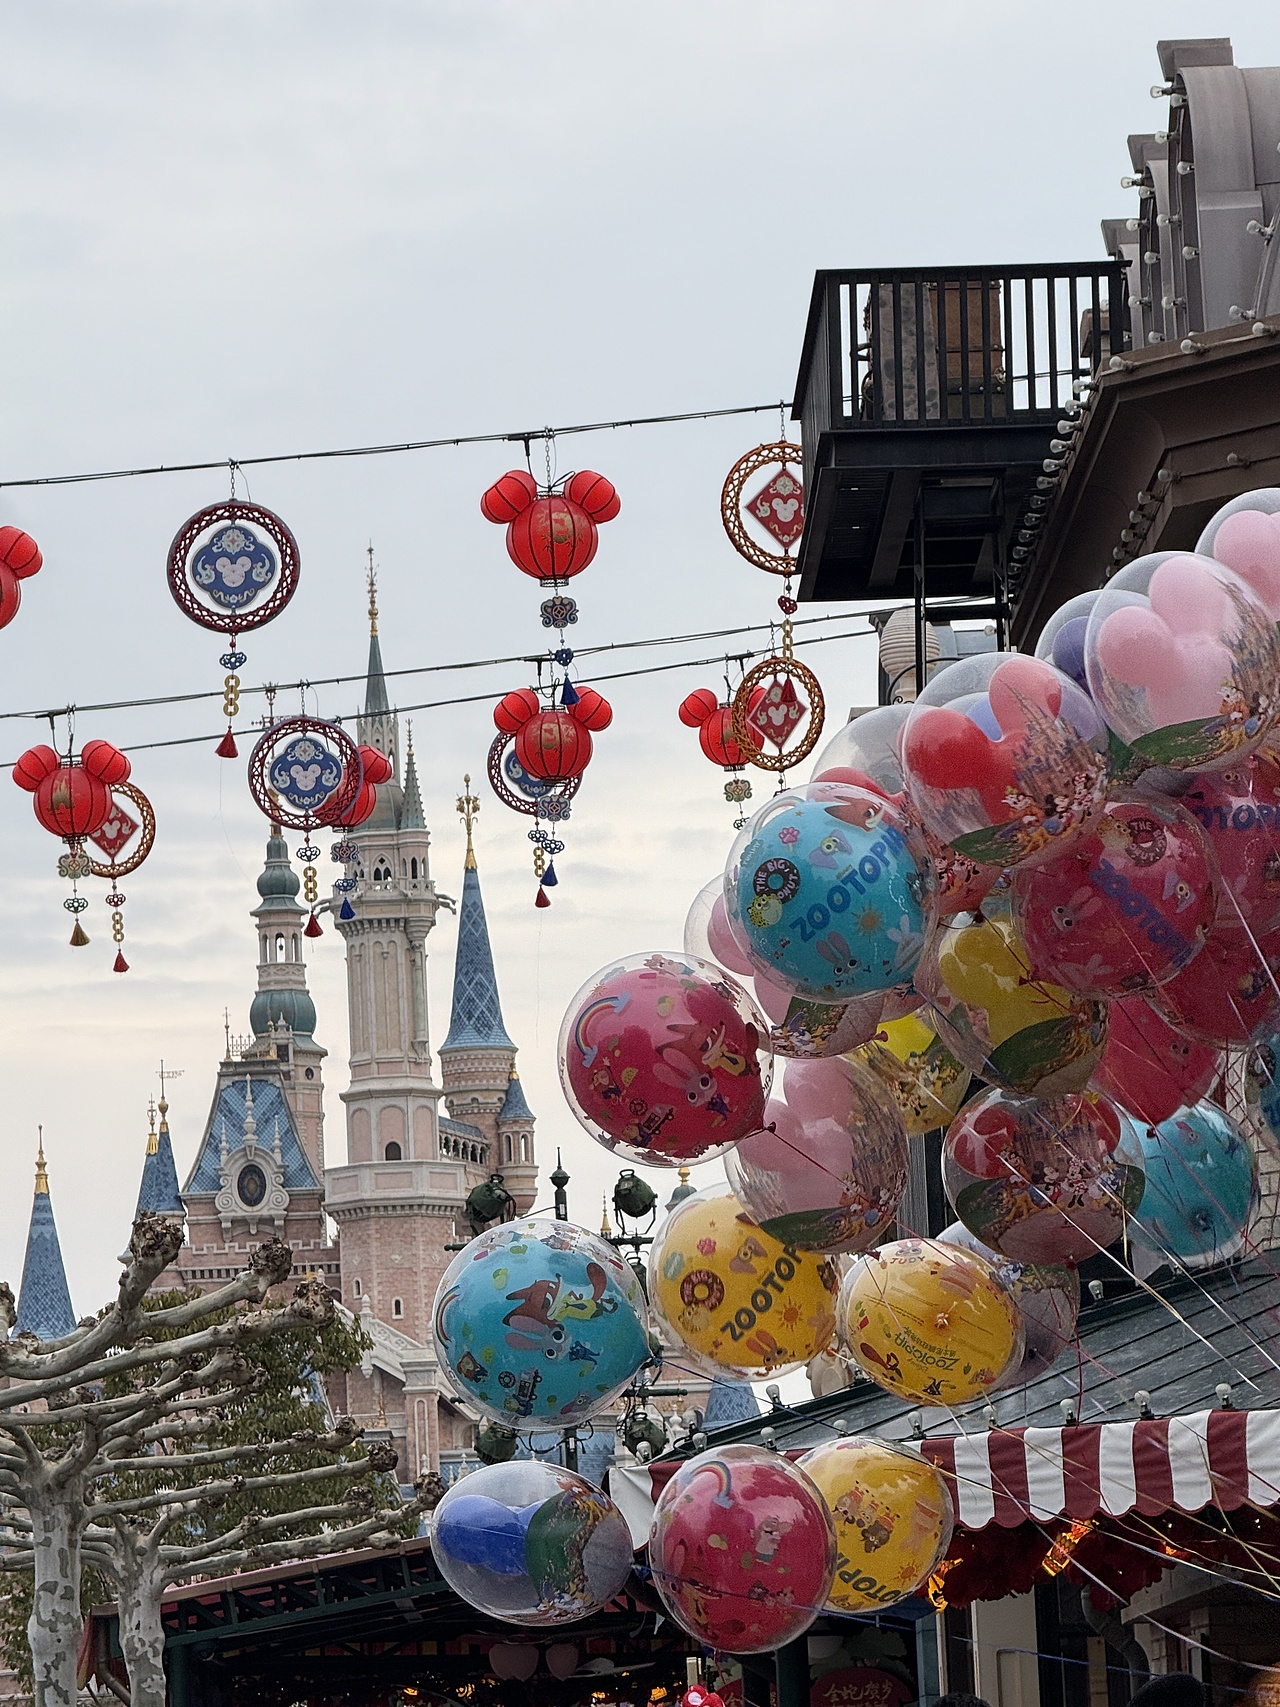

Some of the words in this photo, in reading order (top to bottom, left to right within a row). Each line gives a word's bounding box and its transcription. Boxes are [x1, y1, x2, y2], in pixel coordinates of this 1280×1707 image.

[756, 871, 768, 893] THE
[766, 859, 786, 872] BIG
[777, 873, 798, 900] ONUT
[889, 1255, 926, 1265] JUDY
[836, 1551, 914, 1603] OTOPI
